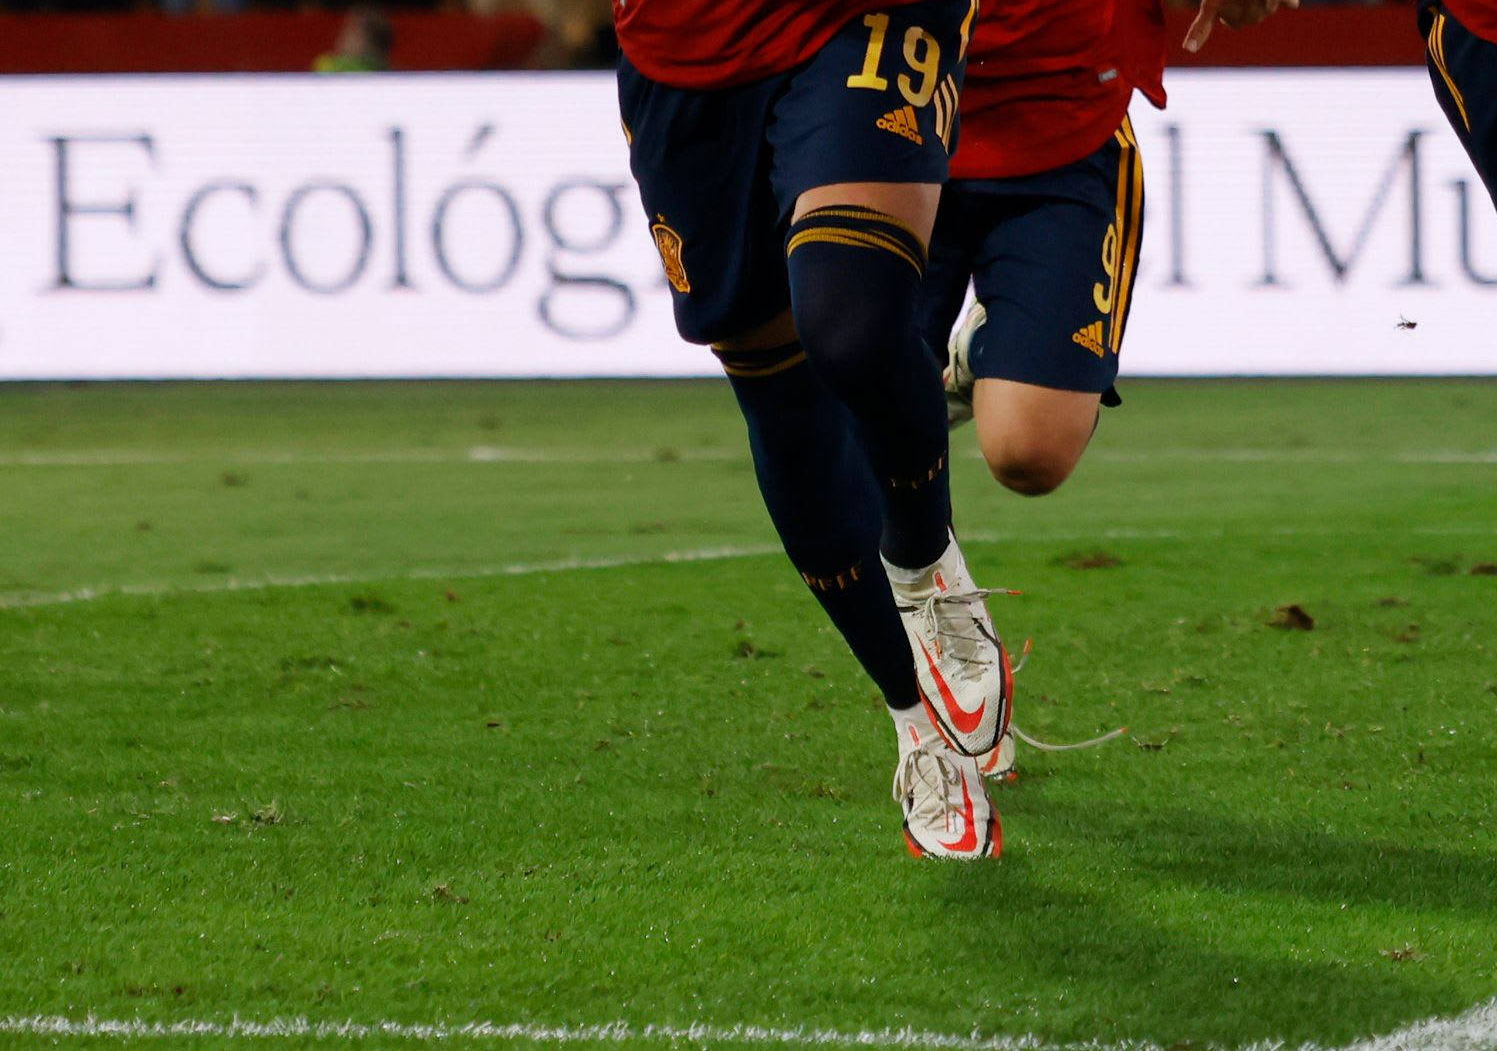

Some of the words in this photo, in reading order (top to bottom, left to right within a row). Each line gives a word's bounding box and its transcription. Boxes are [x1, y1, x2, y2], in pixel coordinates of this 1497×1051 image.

[846, 12, 941, 108] 19
[875, 116, 924, 146] adidas
[43, 124, 660, 341] Ecológ
[1092, 222, 1118, 315] 9
